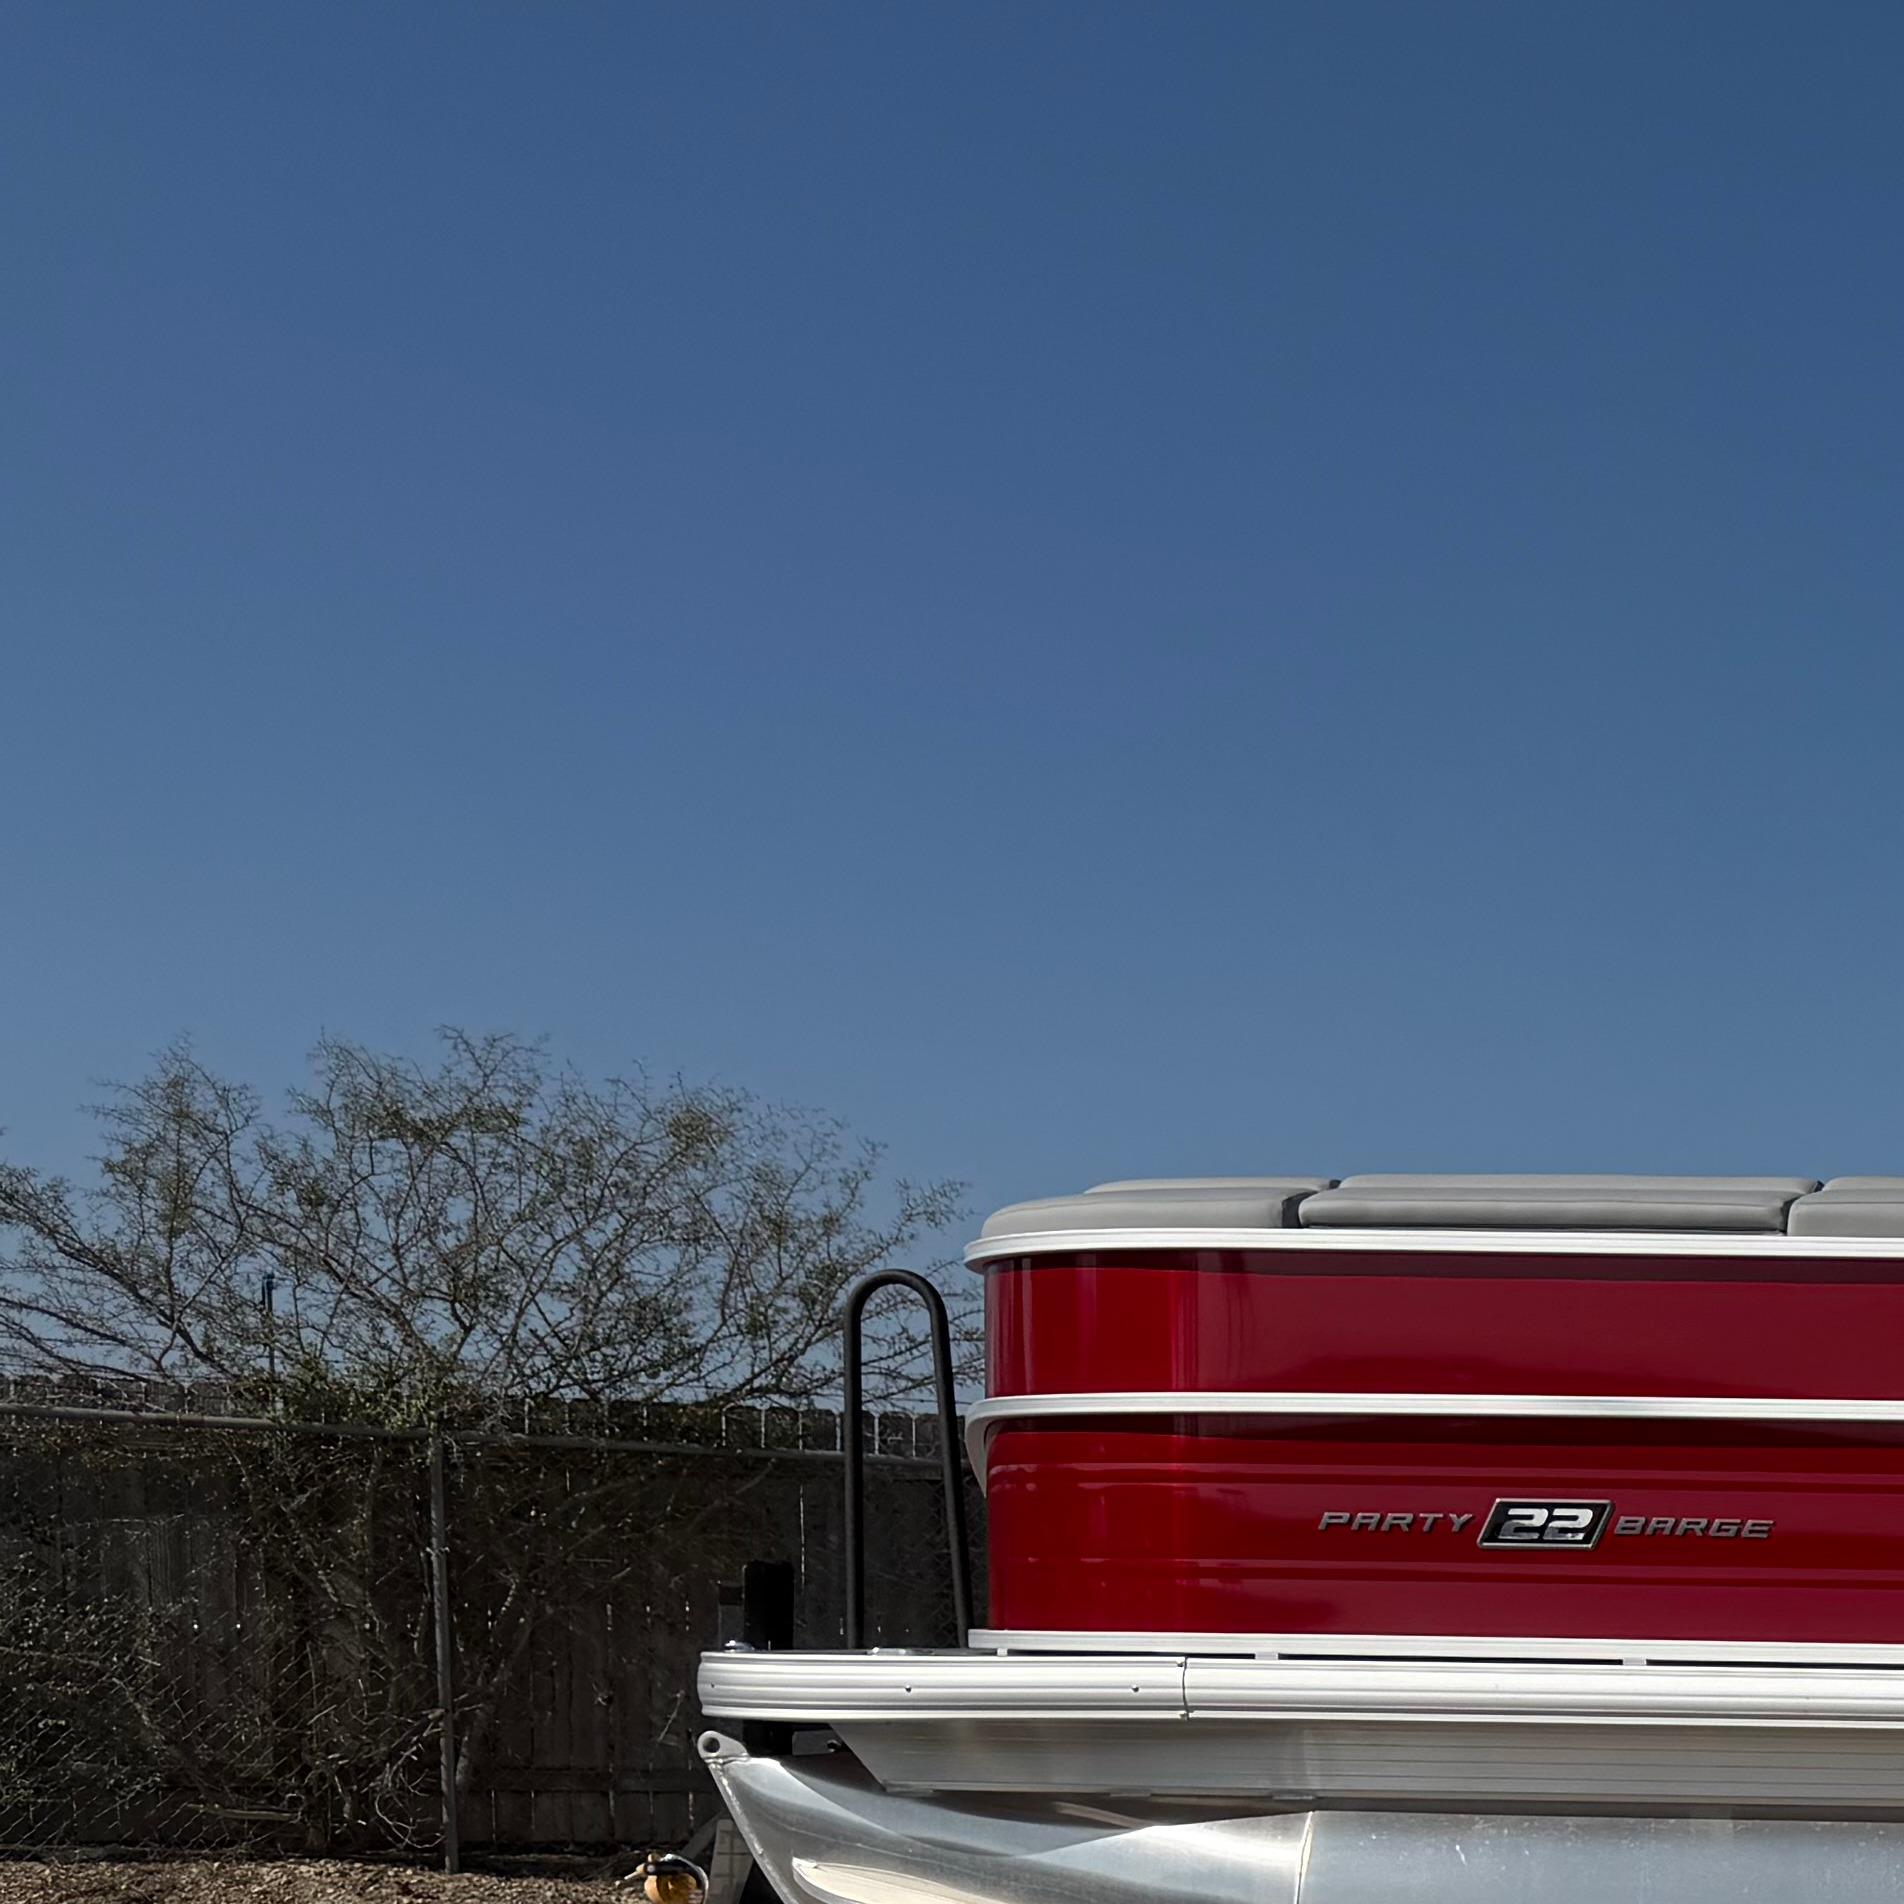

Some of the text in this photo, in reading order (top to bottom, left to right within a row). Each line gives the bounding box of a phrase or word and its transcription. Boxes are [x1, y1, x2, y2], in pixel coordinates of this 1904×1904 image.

[1318, 1508, 1774, 1540] PARTY 22 BARGE
